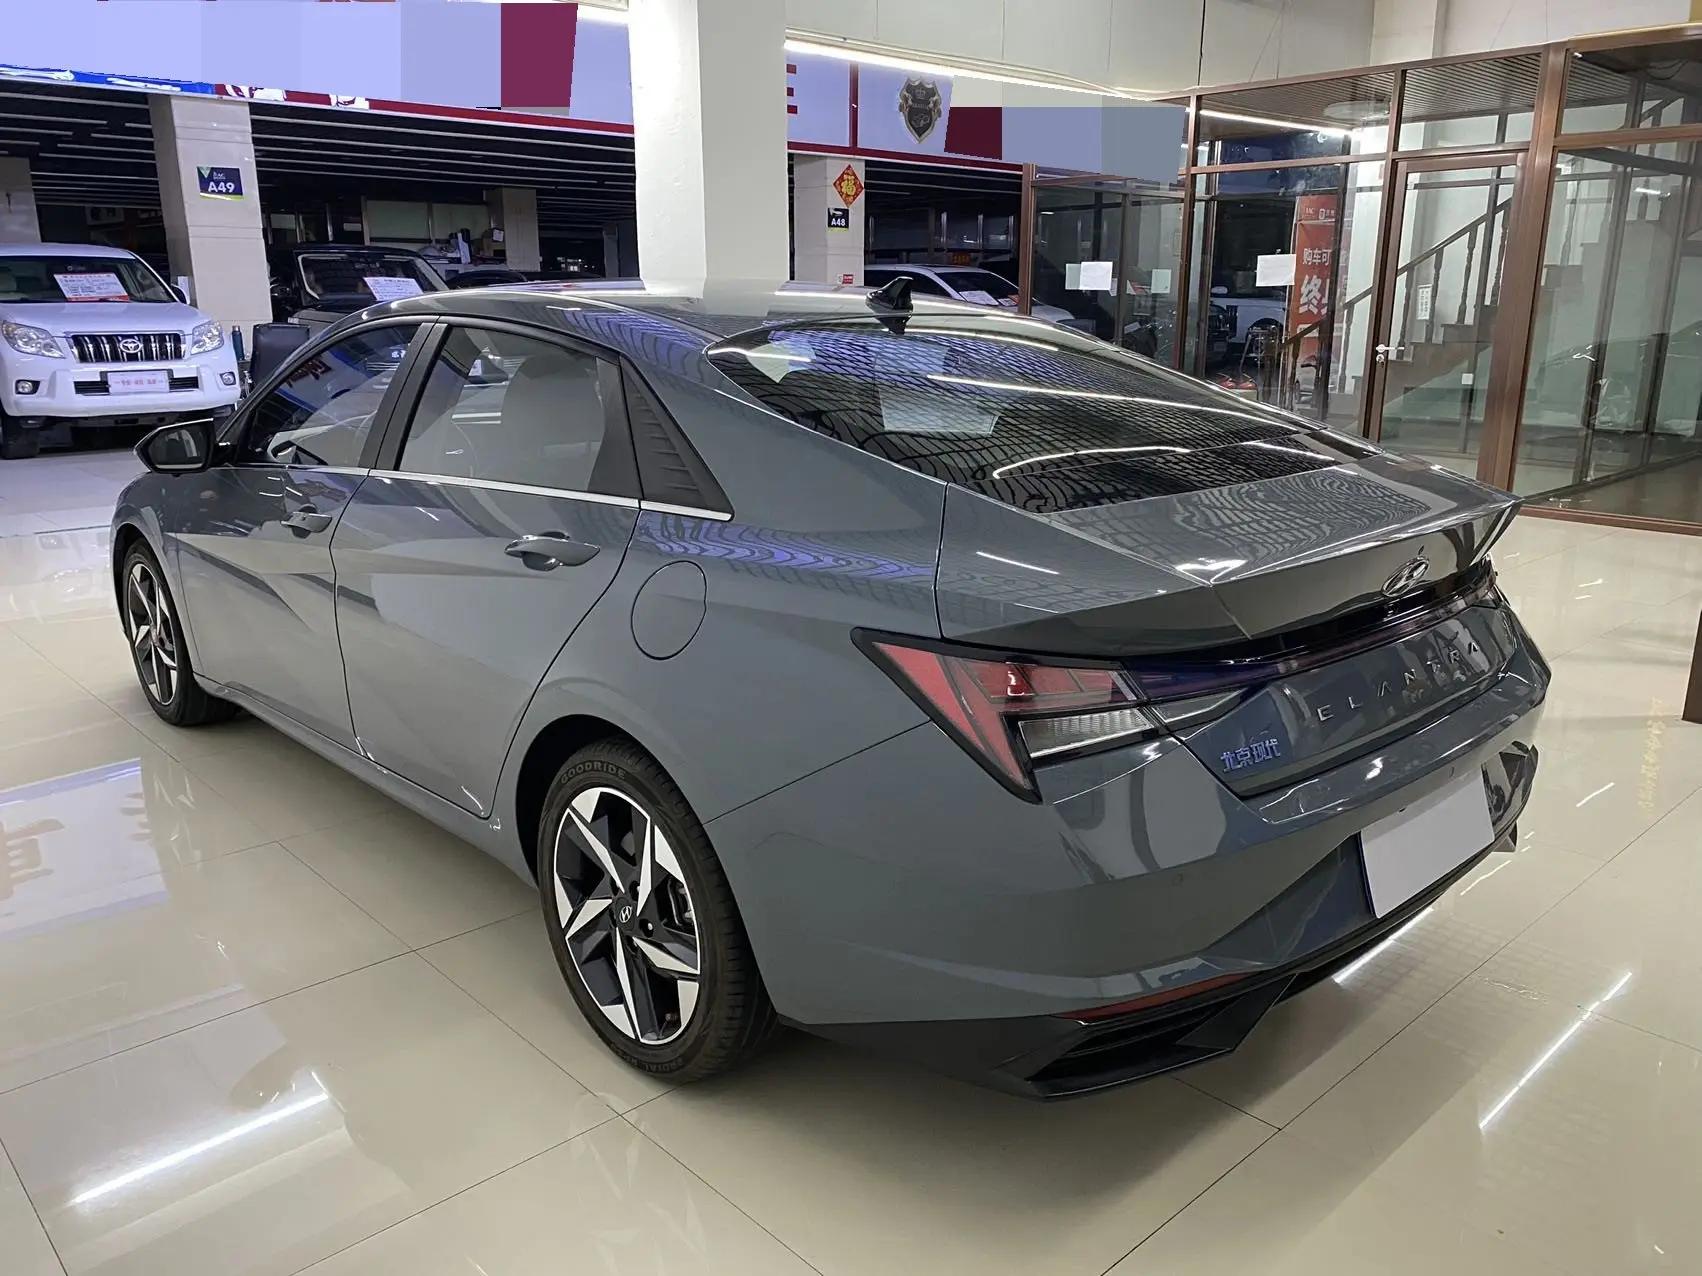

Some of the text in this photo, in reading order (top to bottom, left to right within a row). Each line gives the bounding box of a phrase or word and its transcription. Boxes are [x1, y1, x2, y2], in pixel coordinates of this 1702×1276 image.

[208, 181, 235, 193] A49
[831, 218, 846, 226] A48
[1303, 248, 1332, 265] 购车可
[1316, 642, 1479, 721] ELANTRA
[1220, 738, 1281, 773] 北京现代
[561, 761, 626, 784] GOODRIDE
